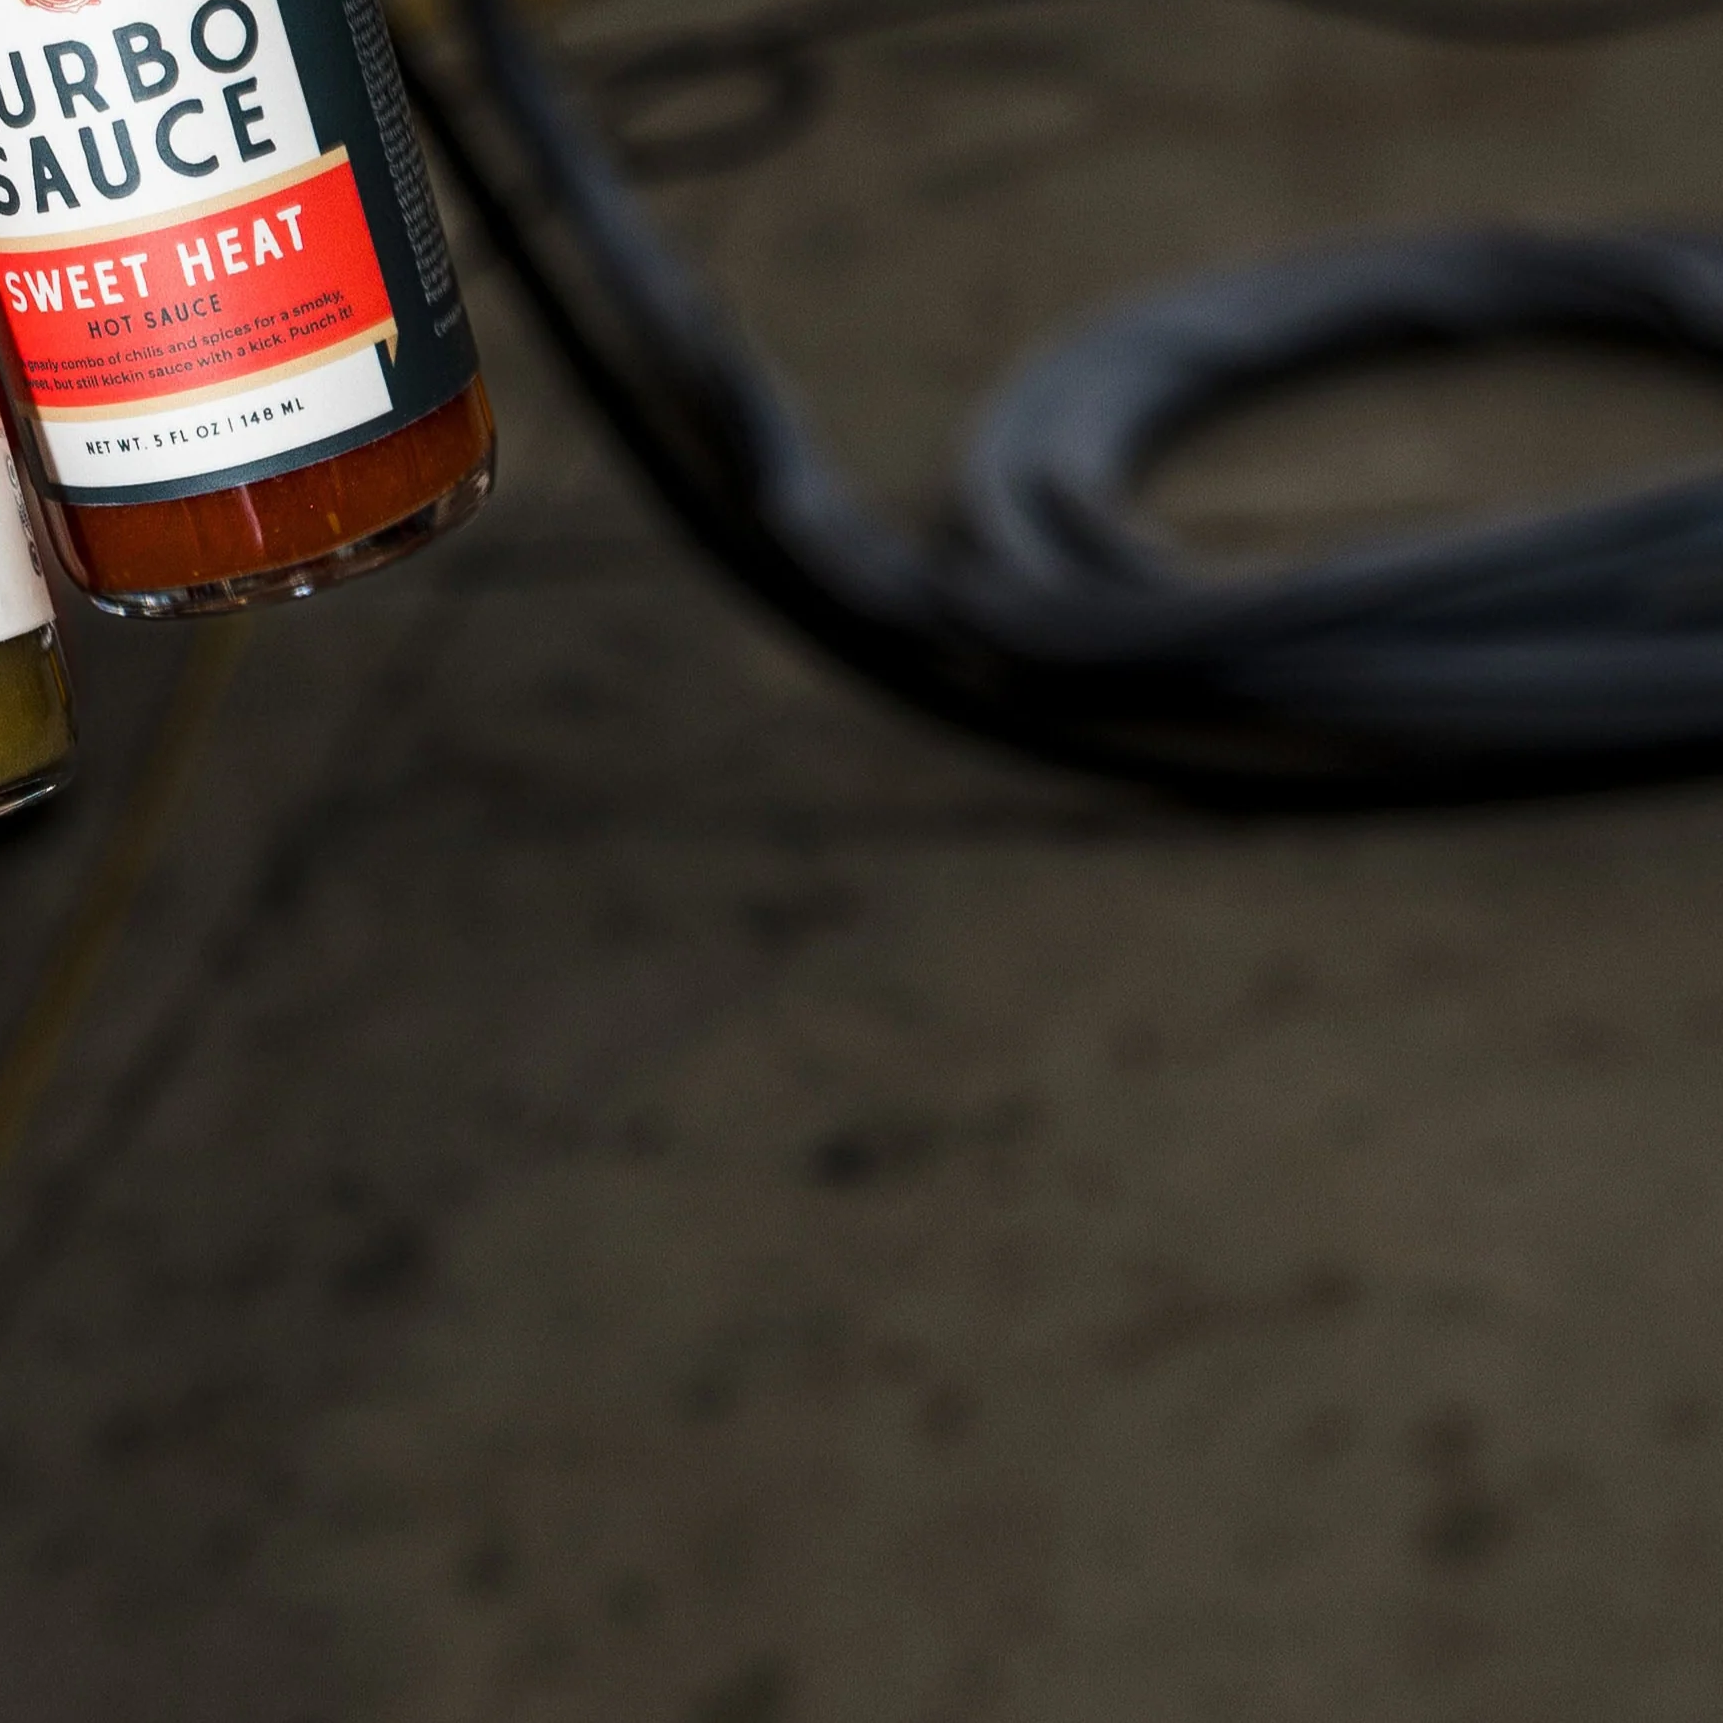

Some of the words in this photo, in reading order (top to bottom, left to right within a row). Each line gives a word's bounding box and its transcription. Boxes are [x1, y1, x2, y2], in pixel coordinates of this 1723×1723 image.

[4, 252, 150, 314] SWEET
[177, 204, 304, 287] HEAT
[54, 378, 74, 391] but
[76, 375, 99, 390] still
[102, 370, 145, 387] kickin
[147, 361, 194, 379] sauce
[196, 349, 233, 367] with
[237, 347, 246, 358] a
[249, 331, 287, 354] kick.
[289, 314, 338, 341] Punch
[339, 304, 354, 324] it!
[61, 356, 105, 370] combo
[108, 353, 122, 365] of
[124, 344, 164, 364] chilis
[168, 335, 198, 354] and
[201, 323, 252, 352] spices
[254, 314, 279, 330] for
[281, 312, 290, 322] a
[292, 288, 345, 318] smoky,
[87, 314, 134, 339] HOT
[144, 294, 222, 329] SAUCE
[86, 440, 111, 456] NET
[116, 436, 148, 454] WT.
[153, 434, 163, 448] 5
[169, 429, 189, 445] FL
[196, 422, 221, 440] OZ
[240, 407, 274, 428] 148
[280, 397, 306, 417] ML
